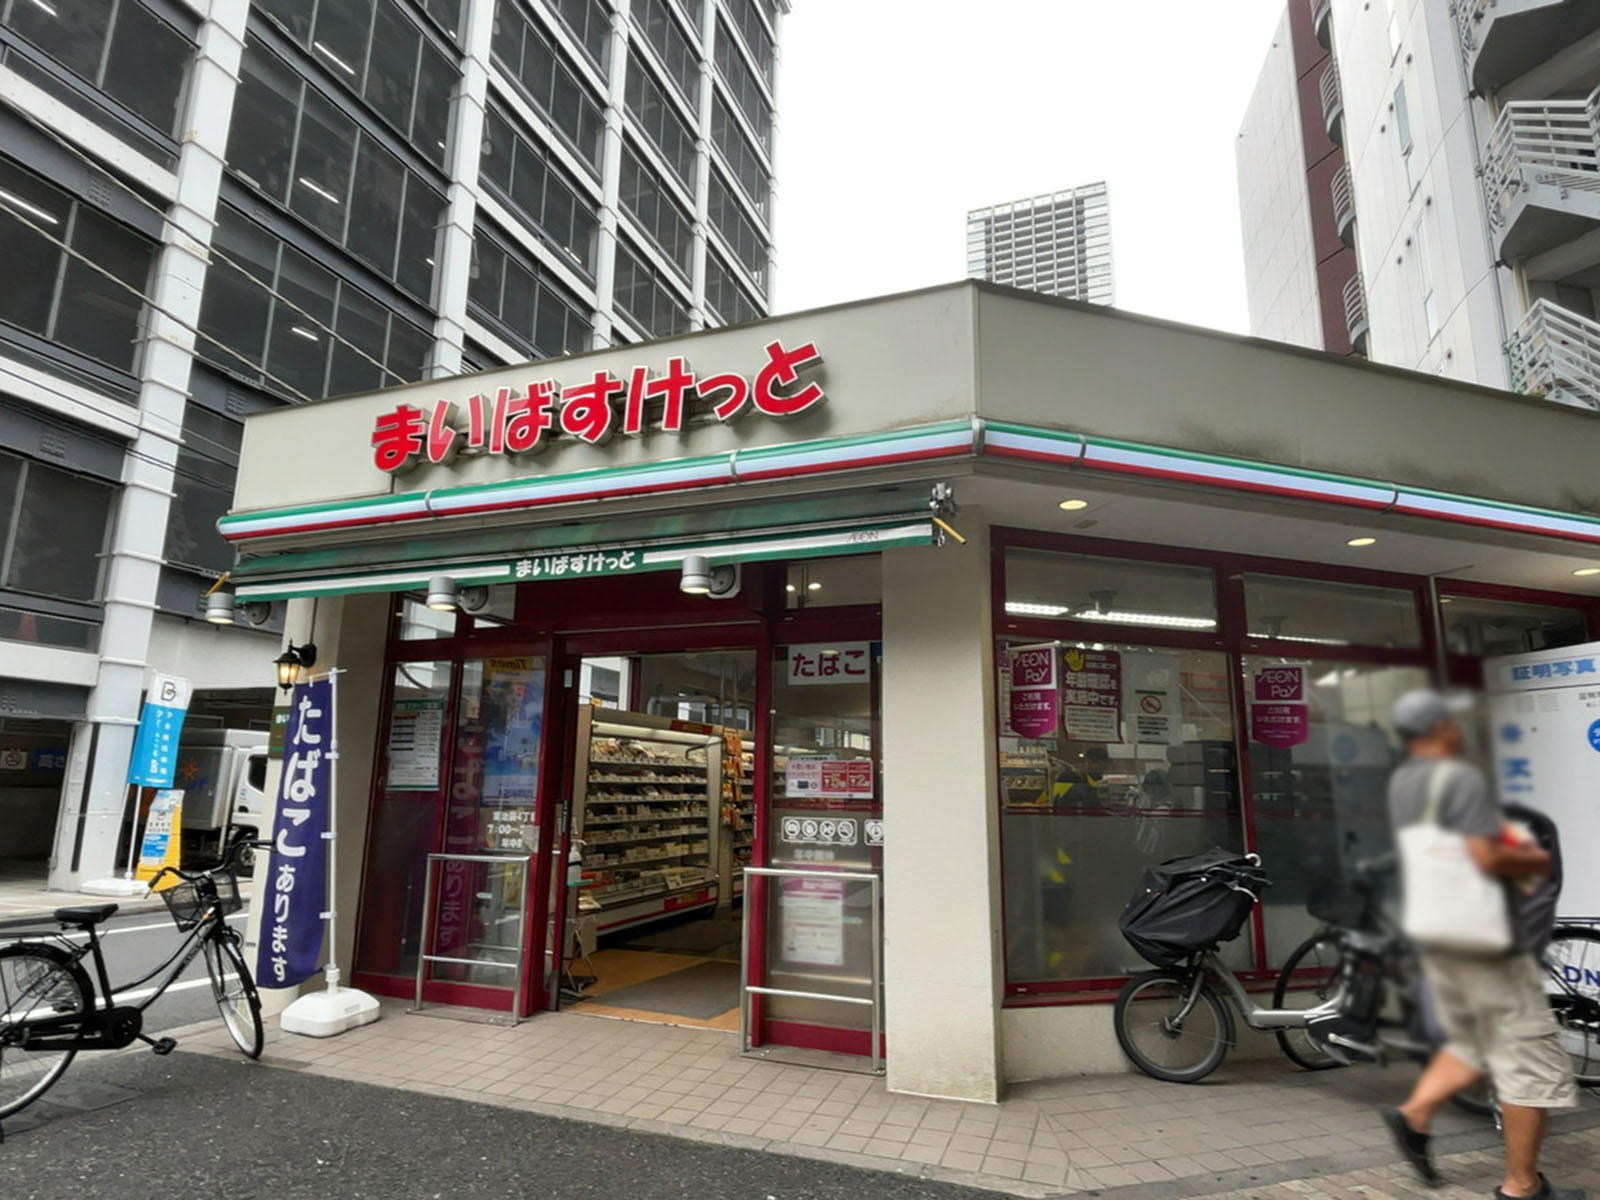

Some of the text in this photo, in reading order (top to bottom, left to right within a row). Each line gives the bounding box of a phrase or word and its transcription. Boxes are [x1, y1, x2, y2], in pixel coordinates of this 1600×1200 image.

[371, 339, 823, 472] まいばすけっと
[515, 550, 636, 577] まいばすけっと
[792, 650, 866, 677] たばこ
[1512, 658, 1596, 681] 証明写真
